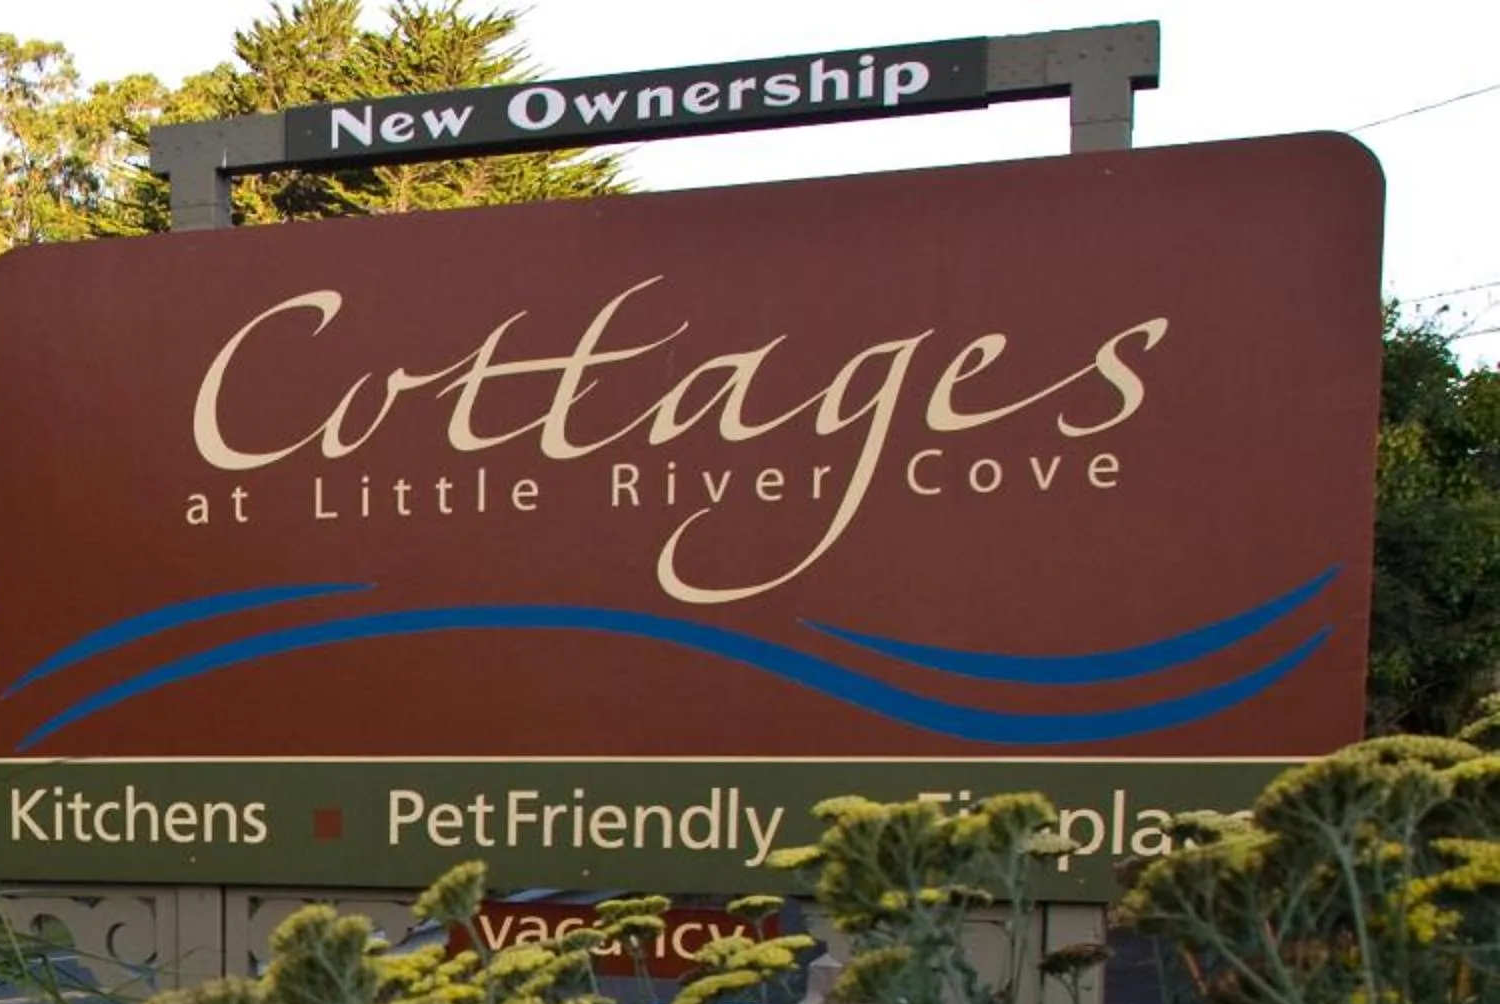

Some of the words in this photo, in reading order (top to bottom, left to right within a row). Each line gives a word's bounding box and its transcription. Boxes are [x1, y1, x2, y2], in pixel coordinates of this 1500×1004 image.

[330, 105, 475, 149] New
[507, 54, 931, 131] Ownership
[192, 275, 1169, 603] Cottages
[186, 486, 249, 525] at
[315, 468, 539, 519] Little
[611, 461, 832, 507] River
[907, 449, 1119, 495] Cove
[11, 785, 268, 843] Kitchens
